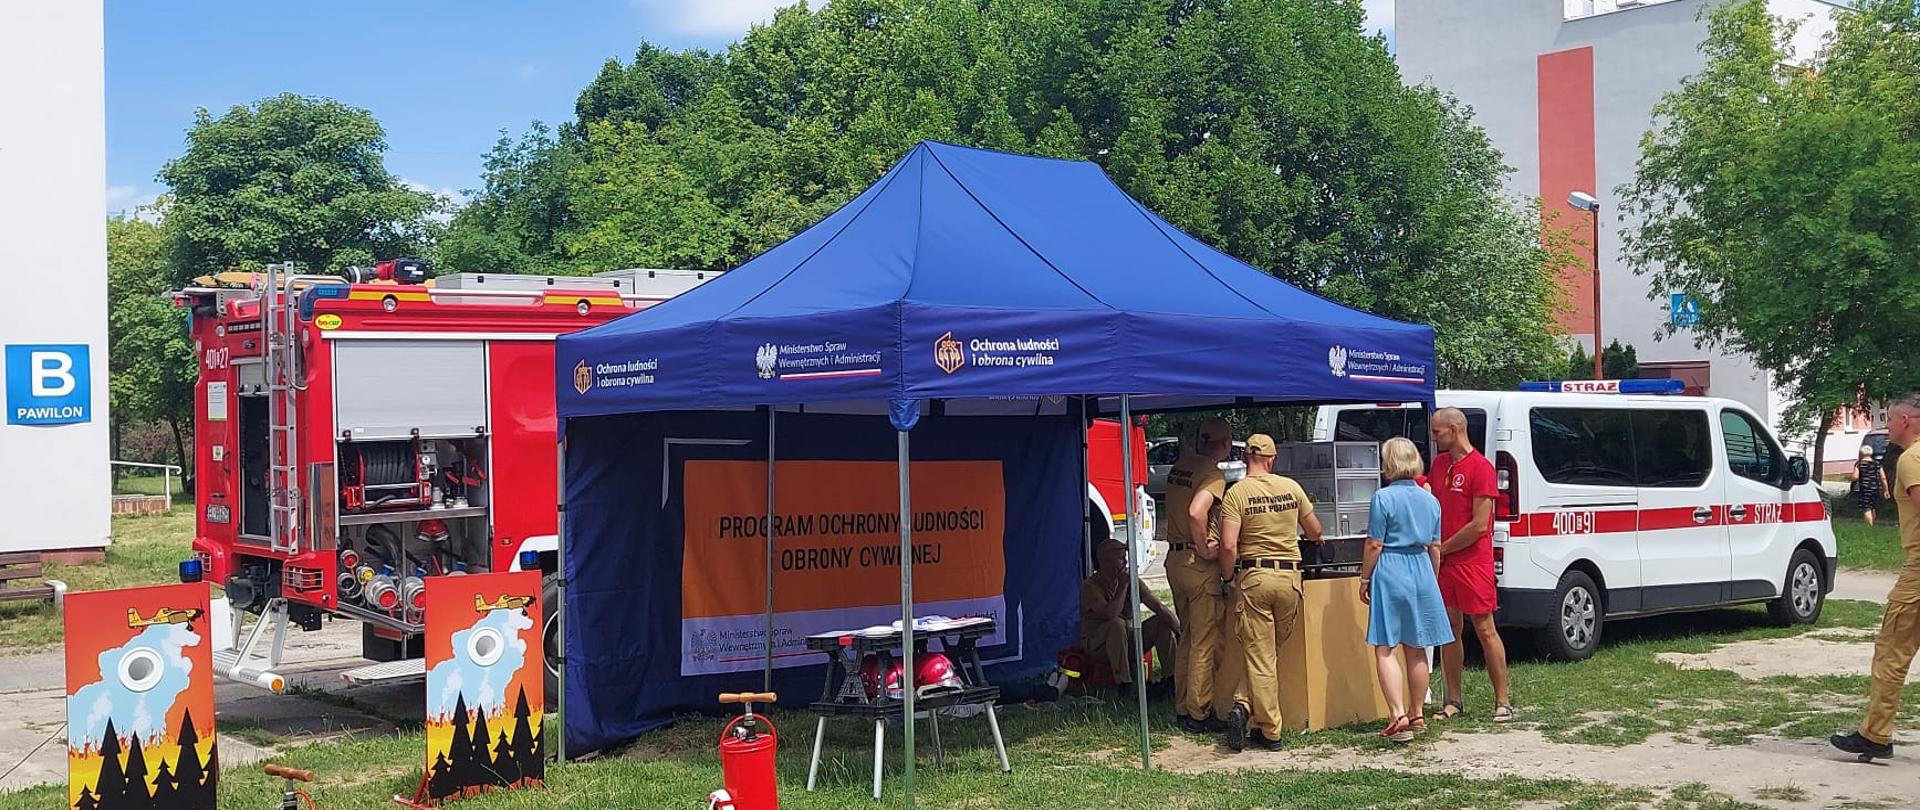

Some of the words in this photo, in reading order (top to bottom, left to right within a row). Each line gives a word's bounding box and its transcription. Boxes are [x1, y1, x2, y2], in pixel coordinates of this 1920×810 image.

[779, 343, 823, 355] Ministerstwo
[824, 341, 847, 354] Spraw
[970, 338, 1016, 352] Ochrona
[1017, 337, 1060, 351] ludności
[596, 362, 627, 375] Ochrona
[627, 357, 658, 372] ludności
[779, 355, 829, 369] Wewnętrznych
[834, 351, 881, 365] Administracji
[972, 353, 976, 366] i
[978, 353, 1013, 367] obrona
[1015, 352, 1054, 368] cywilna
[31, 351, 76, 397] B
[596, 376, 600, 388] i
[601, 376, 626, 388] obrona
[626, 372, 654, 387] cywilna
[17, 406, 83, 419] PAWILON
[719, 514, 814, 539] PROGRAM
[819, 513, 901, 536] OCHRONY
[905, 506, 984, 533] UDNOŚCI
[781, 548, 853, 571] OBRONY
[859, 543, 941, 568] CYWINEJ
